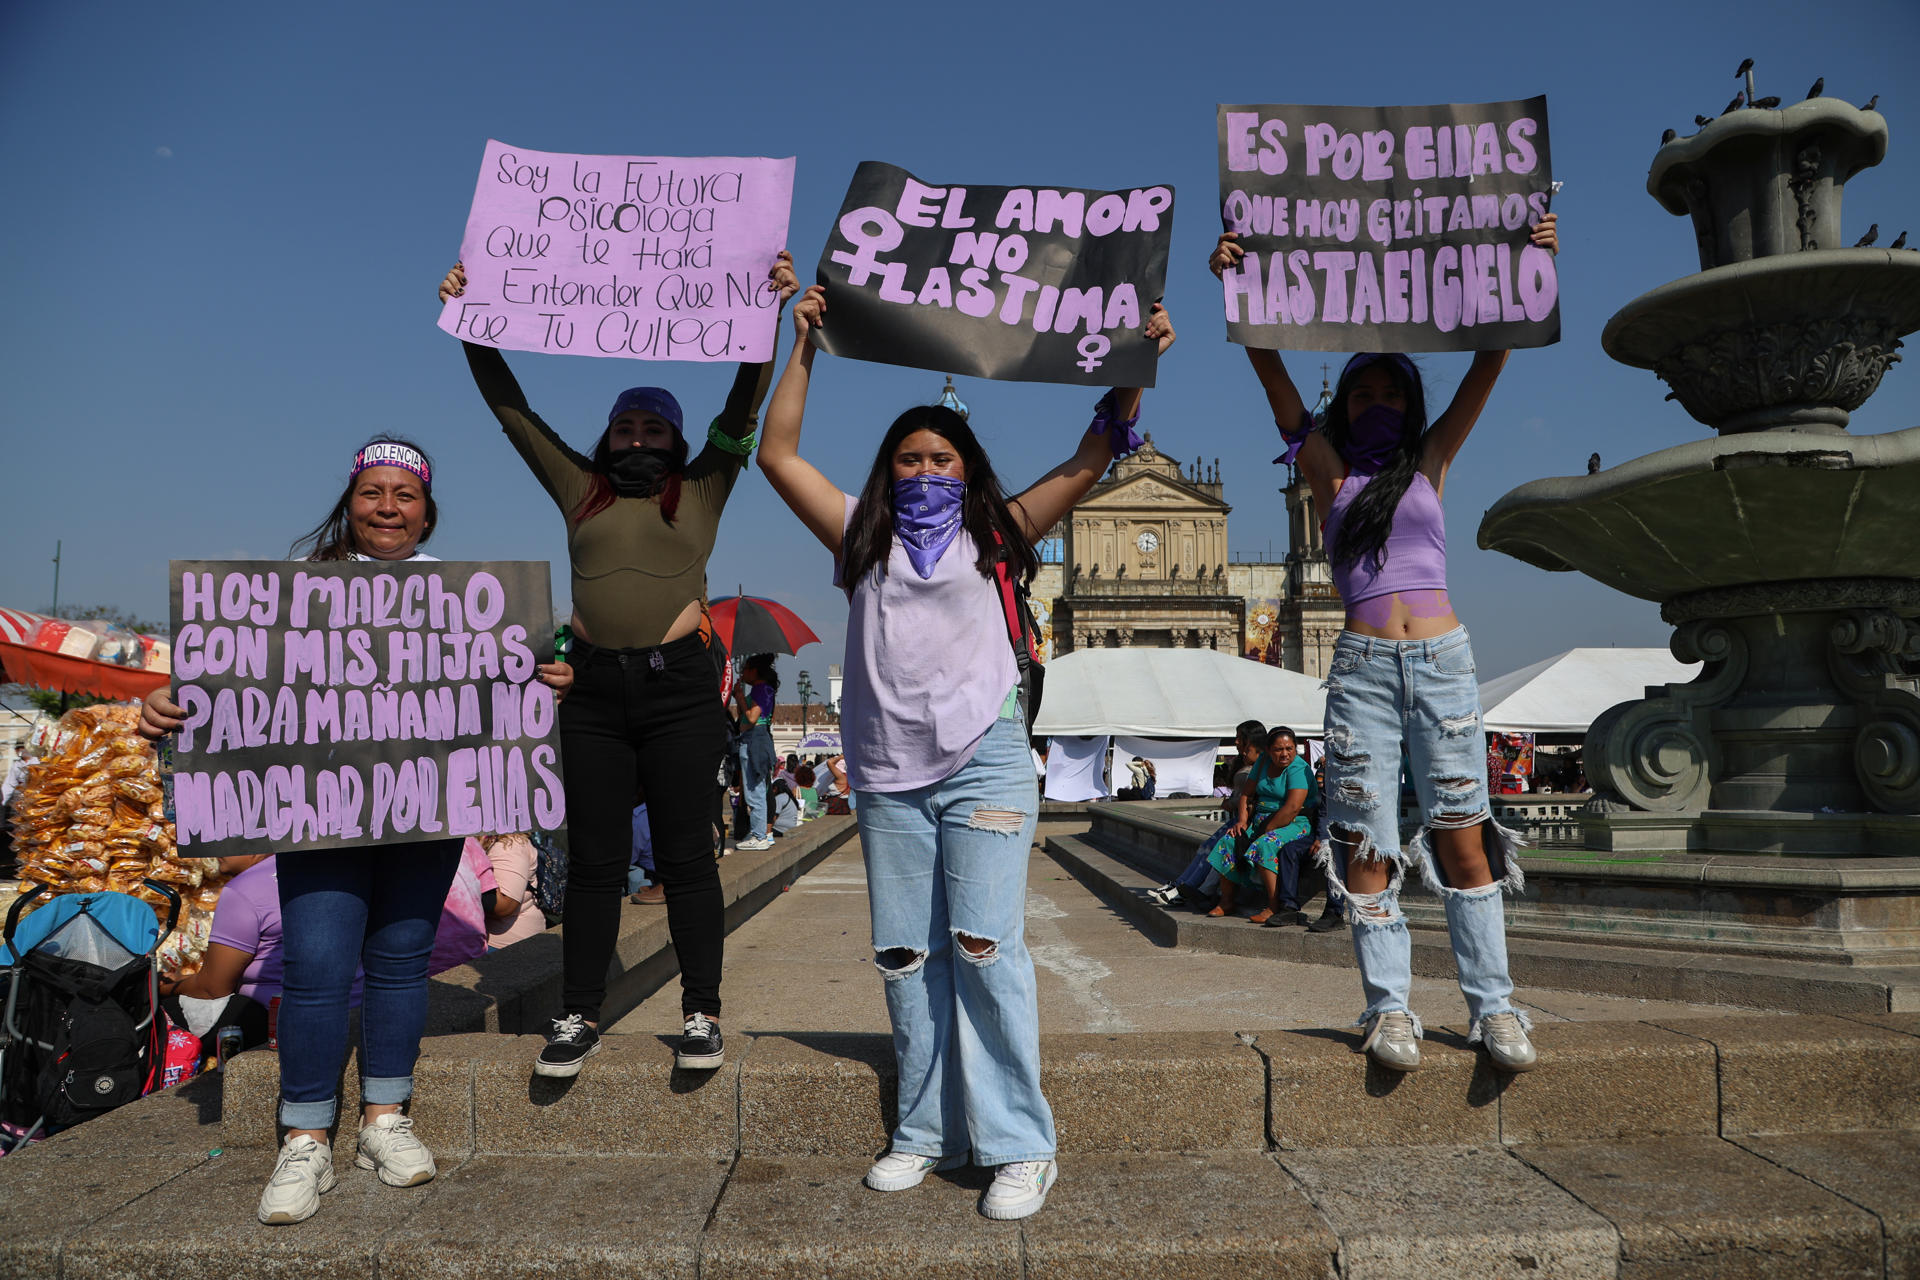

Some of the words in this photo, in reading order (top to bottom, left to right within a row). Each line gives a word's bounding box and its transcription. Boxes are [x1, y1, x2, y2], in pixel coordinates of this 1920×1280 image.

[1226, 112, 1288, 176] ES
[1304, 122, 1395, 182] POR
[497, 153, 549, 193] Soy
[573, 161, 600, 193] la
[624, 161, 743, 207] Futura
[896, 178, 976, 229] EL
[994, 187, 1172, 239] AMOR
[1223, 190, 1289, 238] QUE
[1296, 199, 1360, 242] HOY
[486, 225, 551, 259] Que
[576, 233, 611, 265] te
[633, 239, 713, 271] Hará
[949, 232, 1029, 274] NO
[503, 268, 642, 306] Entender
[656, 274, 713, 311] Que
[726, 272, 778, 309] No
[879, 262, 1141, 334] LASTIMA
[1222, 249, 1385, 325] HASTA
[456, 303, 508, 344] Fue
[538, 313, 574, 349] Tu
[366, 445, 420, 470] VIOLENCIA
[182, 571, 280, 626] HOY
[174, 624, 268, 681] CON
[284, 629, 378, 687] MIS
[387, 624, 535, 685] HIJAS
[177, 685, 298, 753] PARA
[304, 682, 482, 744] MAÑANA
[491, 679, 554, 741] NO
[370, 756, 443, 839] POR
